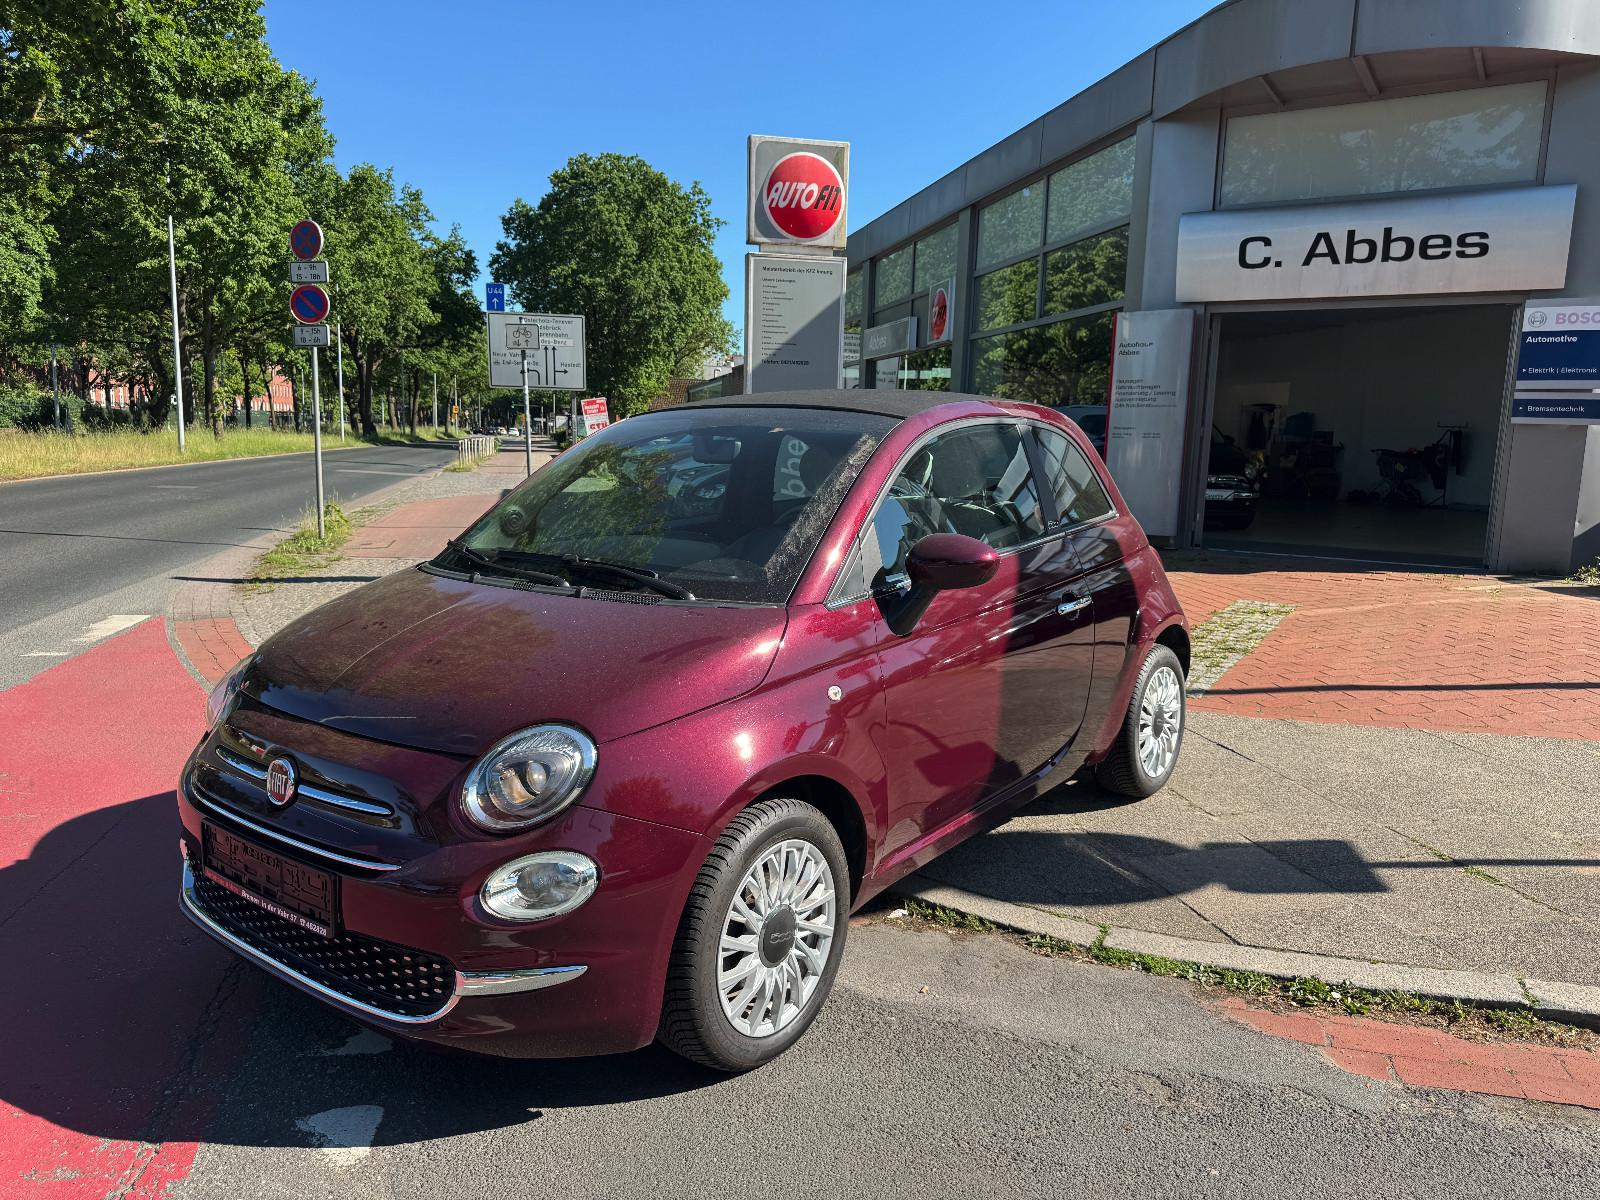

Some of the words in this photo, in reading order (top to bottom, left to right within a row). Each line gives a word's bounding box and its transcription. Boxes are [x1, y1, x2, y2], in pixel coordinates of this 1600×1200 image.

[767, 181, 842, 211] AUTOFIT
[1238, 236, 1282, 269] C.
[1301, 227, 1490, 266] Abbes
[310, 273, 321, 281] 18h
[1526, 335, 1578, 343] Automotive
[1527, 405, 1585, 413] Bremsentechnik
[271, 772, 288, 795] FIAT
